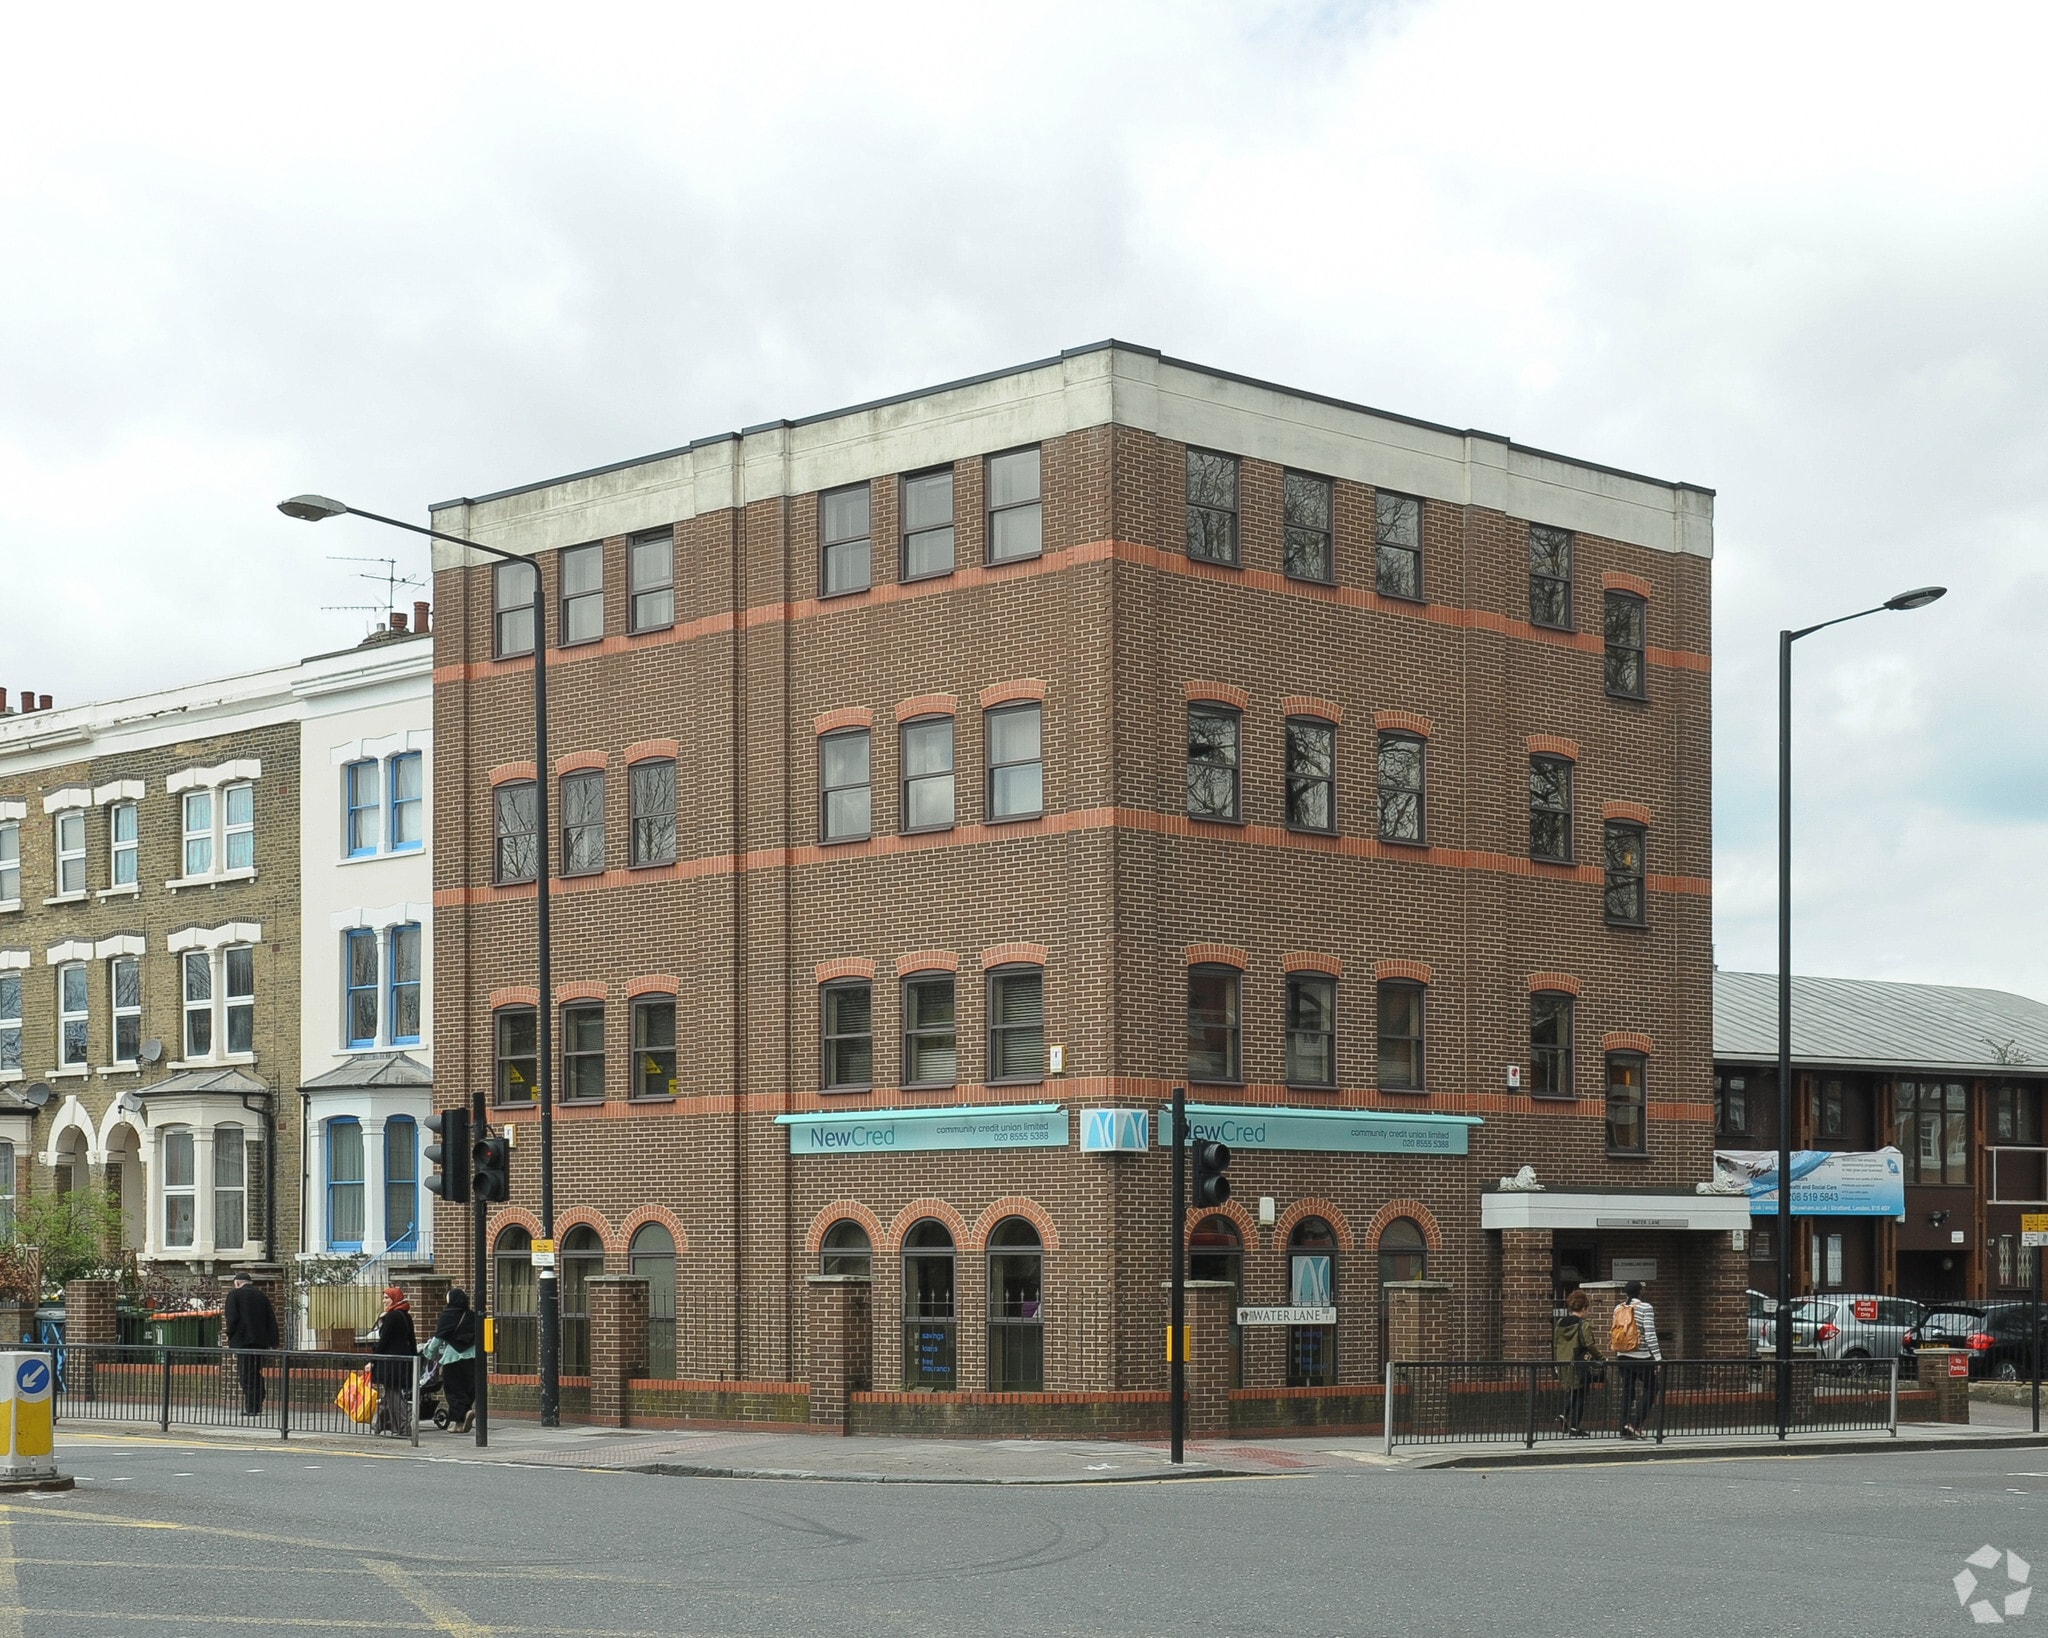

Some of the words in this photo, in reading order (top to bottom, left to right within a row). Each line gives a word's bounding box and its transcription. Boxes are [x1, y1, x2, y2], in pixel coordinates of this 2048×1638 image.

[936, 1125, 976, 1135] community
[978, 1123, 999, 1133] credit
[1001, 1123, 1022, 1132] union
[1023, 1121, 1049, 1131] limited
[811, 1125, 895, 1147] NewCred
[993, 1133, 1008, 1141] 020
[1009, 1132, 1029, 1141] 8555
[1350, 1129, 1387, 1139] community
[1389, 1129, 1407, 1139] credit
[1408, 1130, 1427, 1139] union
[1428, 1130, 1449, 1140] limited
[1402, 1139, 1415, 1148] 020
[1416, 1139, 1432, 1148] 8555
[1791, 1192, 1802, 1201] 08
[1803, 1192, 1818, 1201] 519
[1819, 1192, 1839, 1201] 5843
[1253, 1310, 1291, 1321] WATER
[1293, 1310, 1320, 1321] LANE
[922, 1333, 944, 1341] savings
